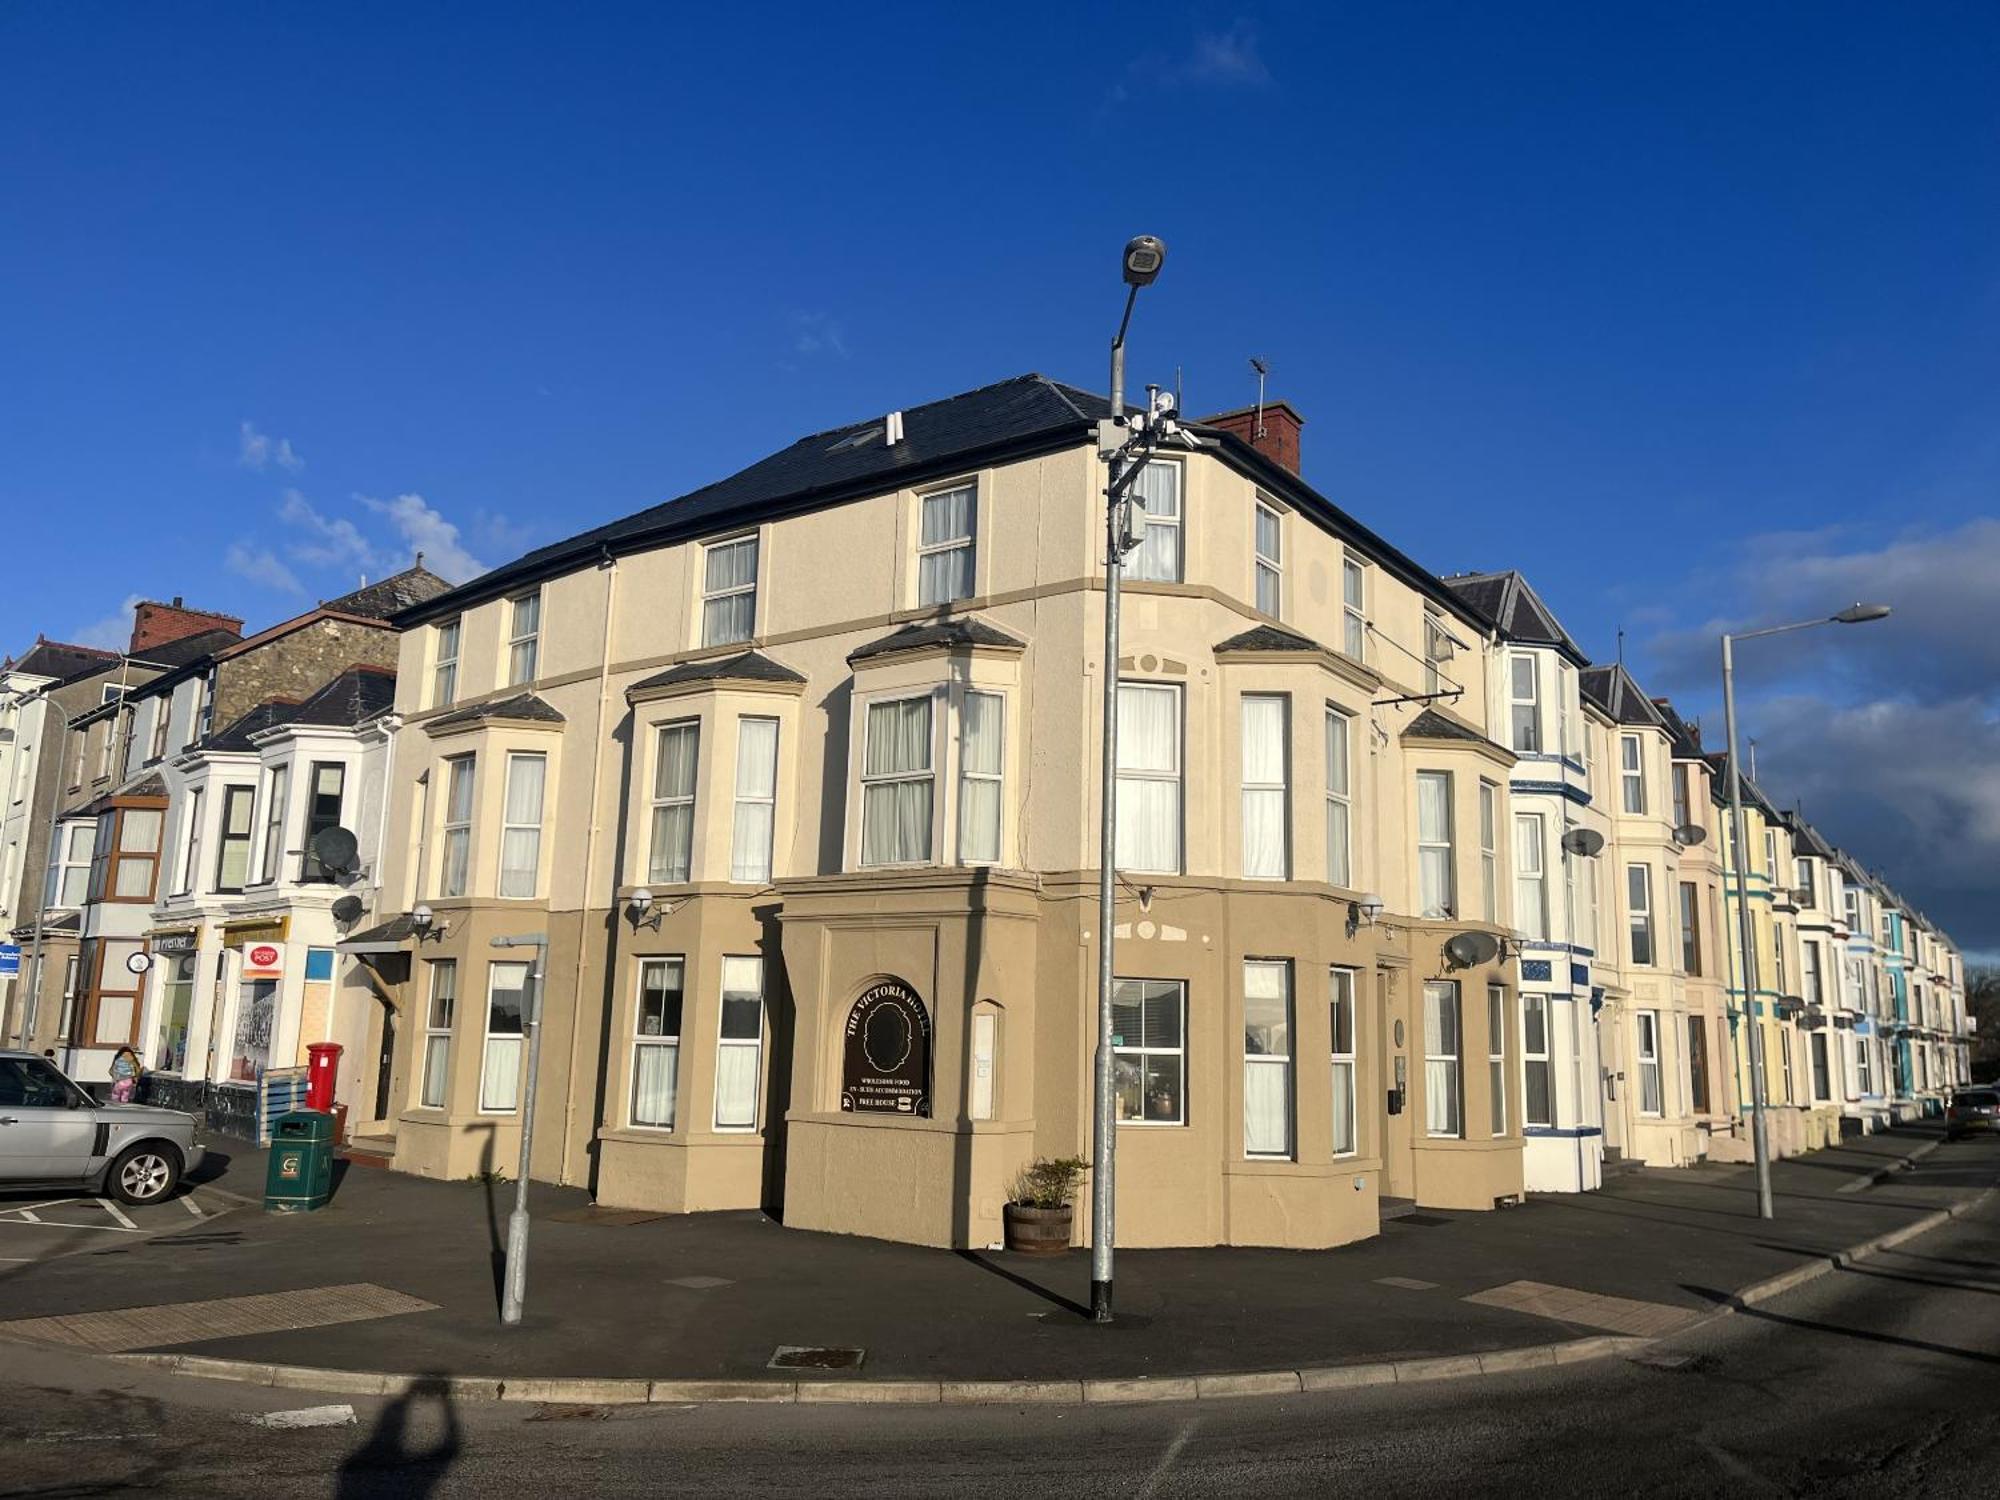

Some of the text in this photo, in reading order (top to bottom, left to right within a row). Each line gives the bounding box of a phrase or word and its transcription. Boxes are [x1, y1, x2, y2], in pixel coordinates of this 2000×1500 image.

[848, 985, 930, 1037] THE VICTORIA HOTEL
